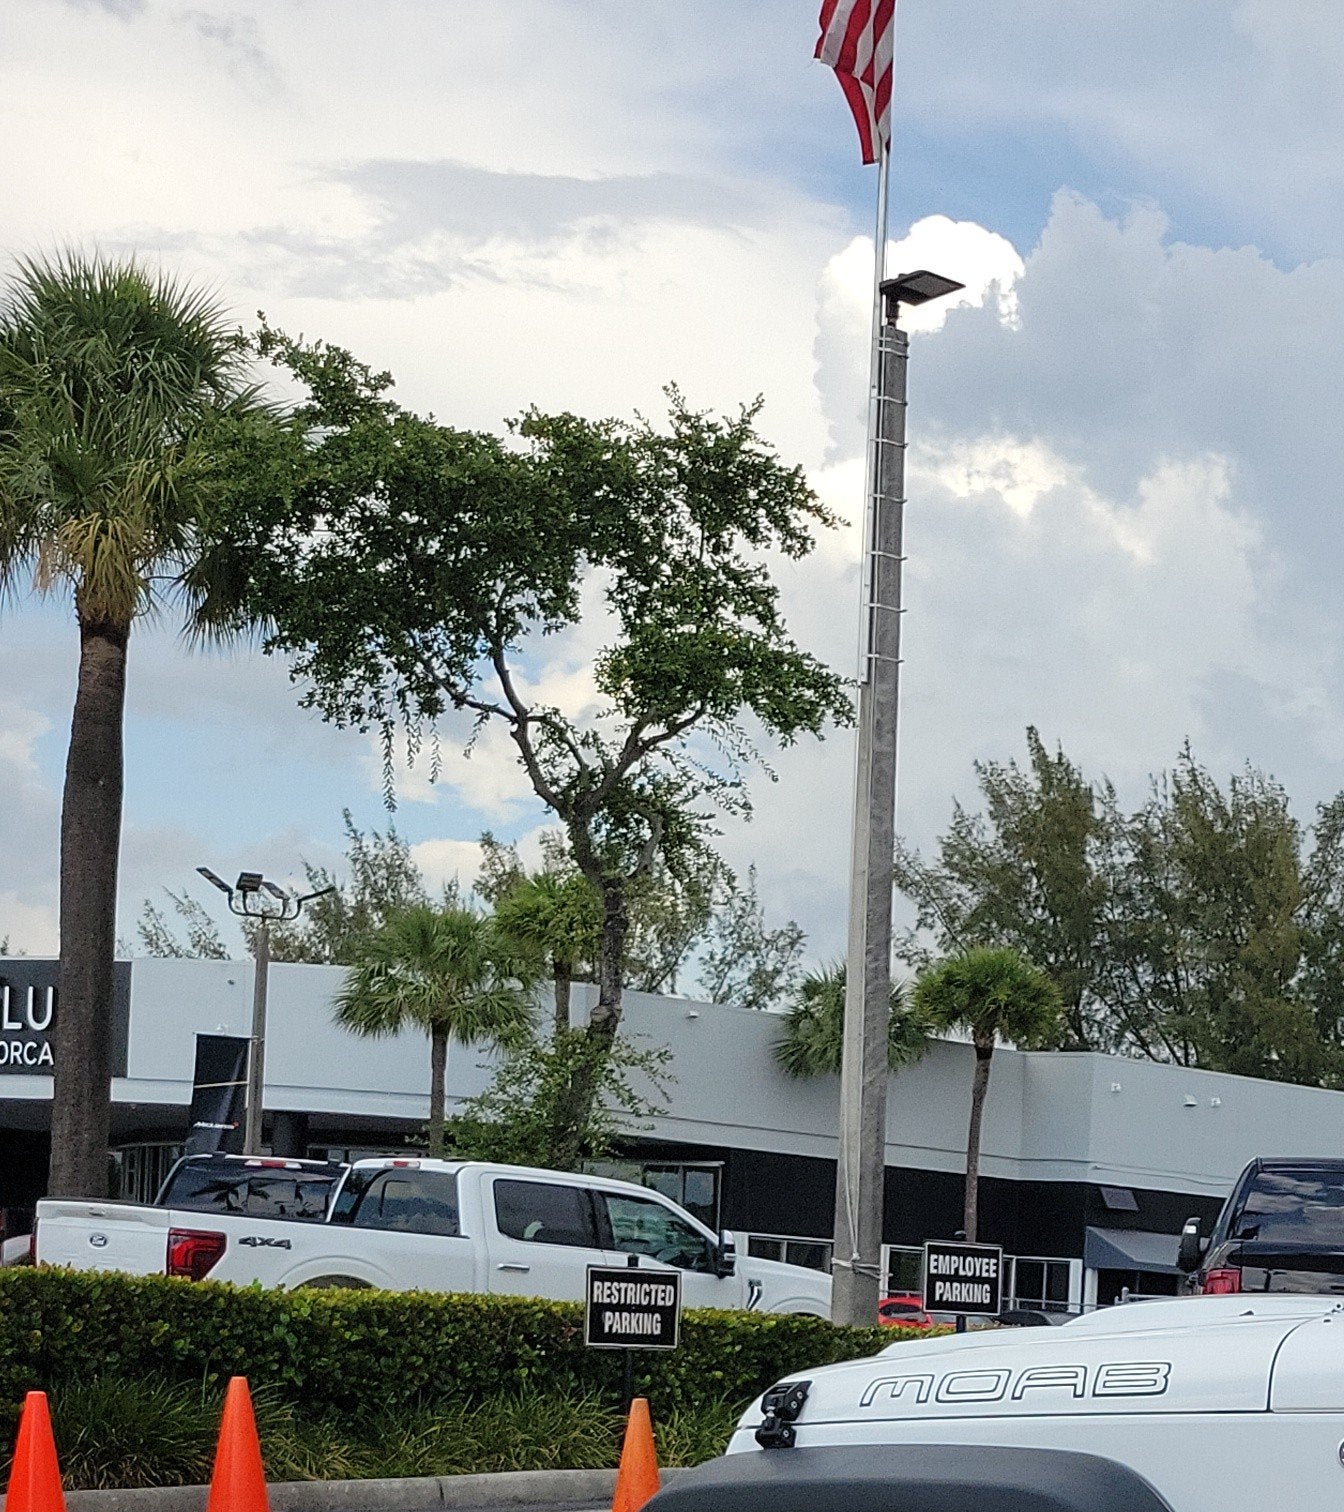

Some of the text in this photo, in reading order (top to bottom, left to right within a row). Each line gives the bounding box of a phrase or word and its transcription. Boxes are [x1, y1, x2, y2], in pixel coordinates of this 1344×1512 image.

[3, 986, 54, 1031] LU
[929, 1253, 998, 1278] EMPLOYEE
[592, 1280, 675, 1307] RESTRICTED
[934, 1281, 991, 1304] PARKING
[603, 1311, 662, 1335] PARKING
[859, 1361, 1172, 1407] MOAB
